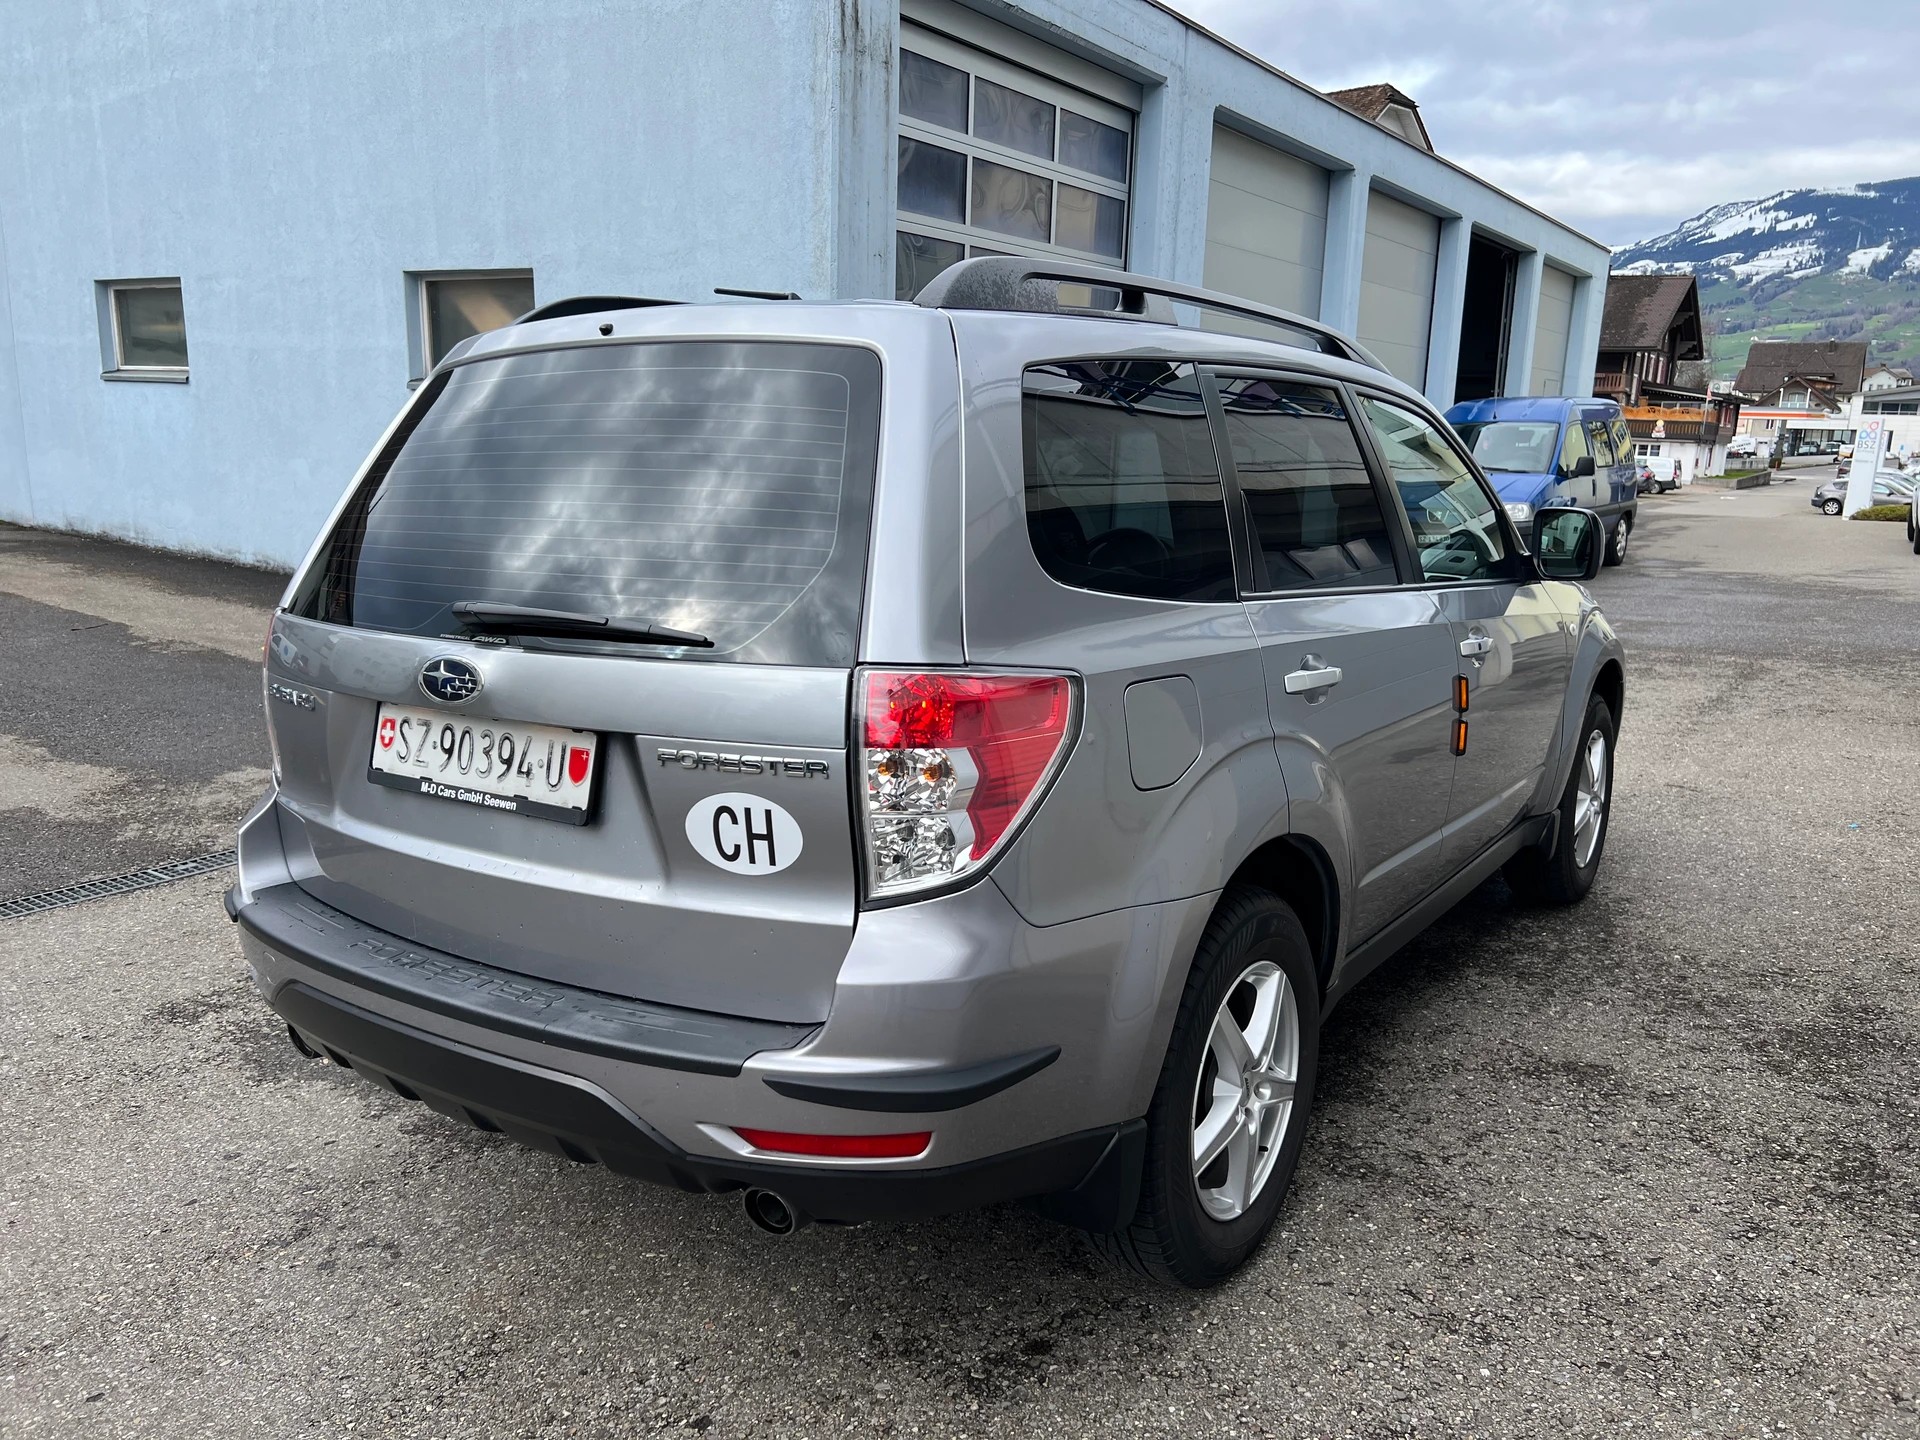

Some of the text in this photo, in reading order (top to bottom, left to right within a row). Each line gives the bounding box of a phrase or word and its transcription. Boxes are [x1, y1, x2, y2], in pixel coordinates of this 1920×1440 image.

[471, 635, 507, 644] AWD
[657, 748, 829, 780] FORESTER
[420, 781, 517, 811] M-D Cars GmbH Seewen
[712, 805, 777, 867] CH
[345, 937, 566, 1009] FORESTER
